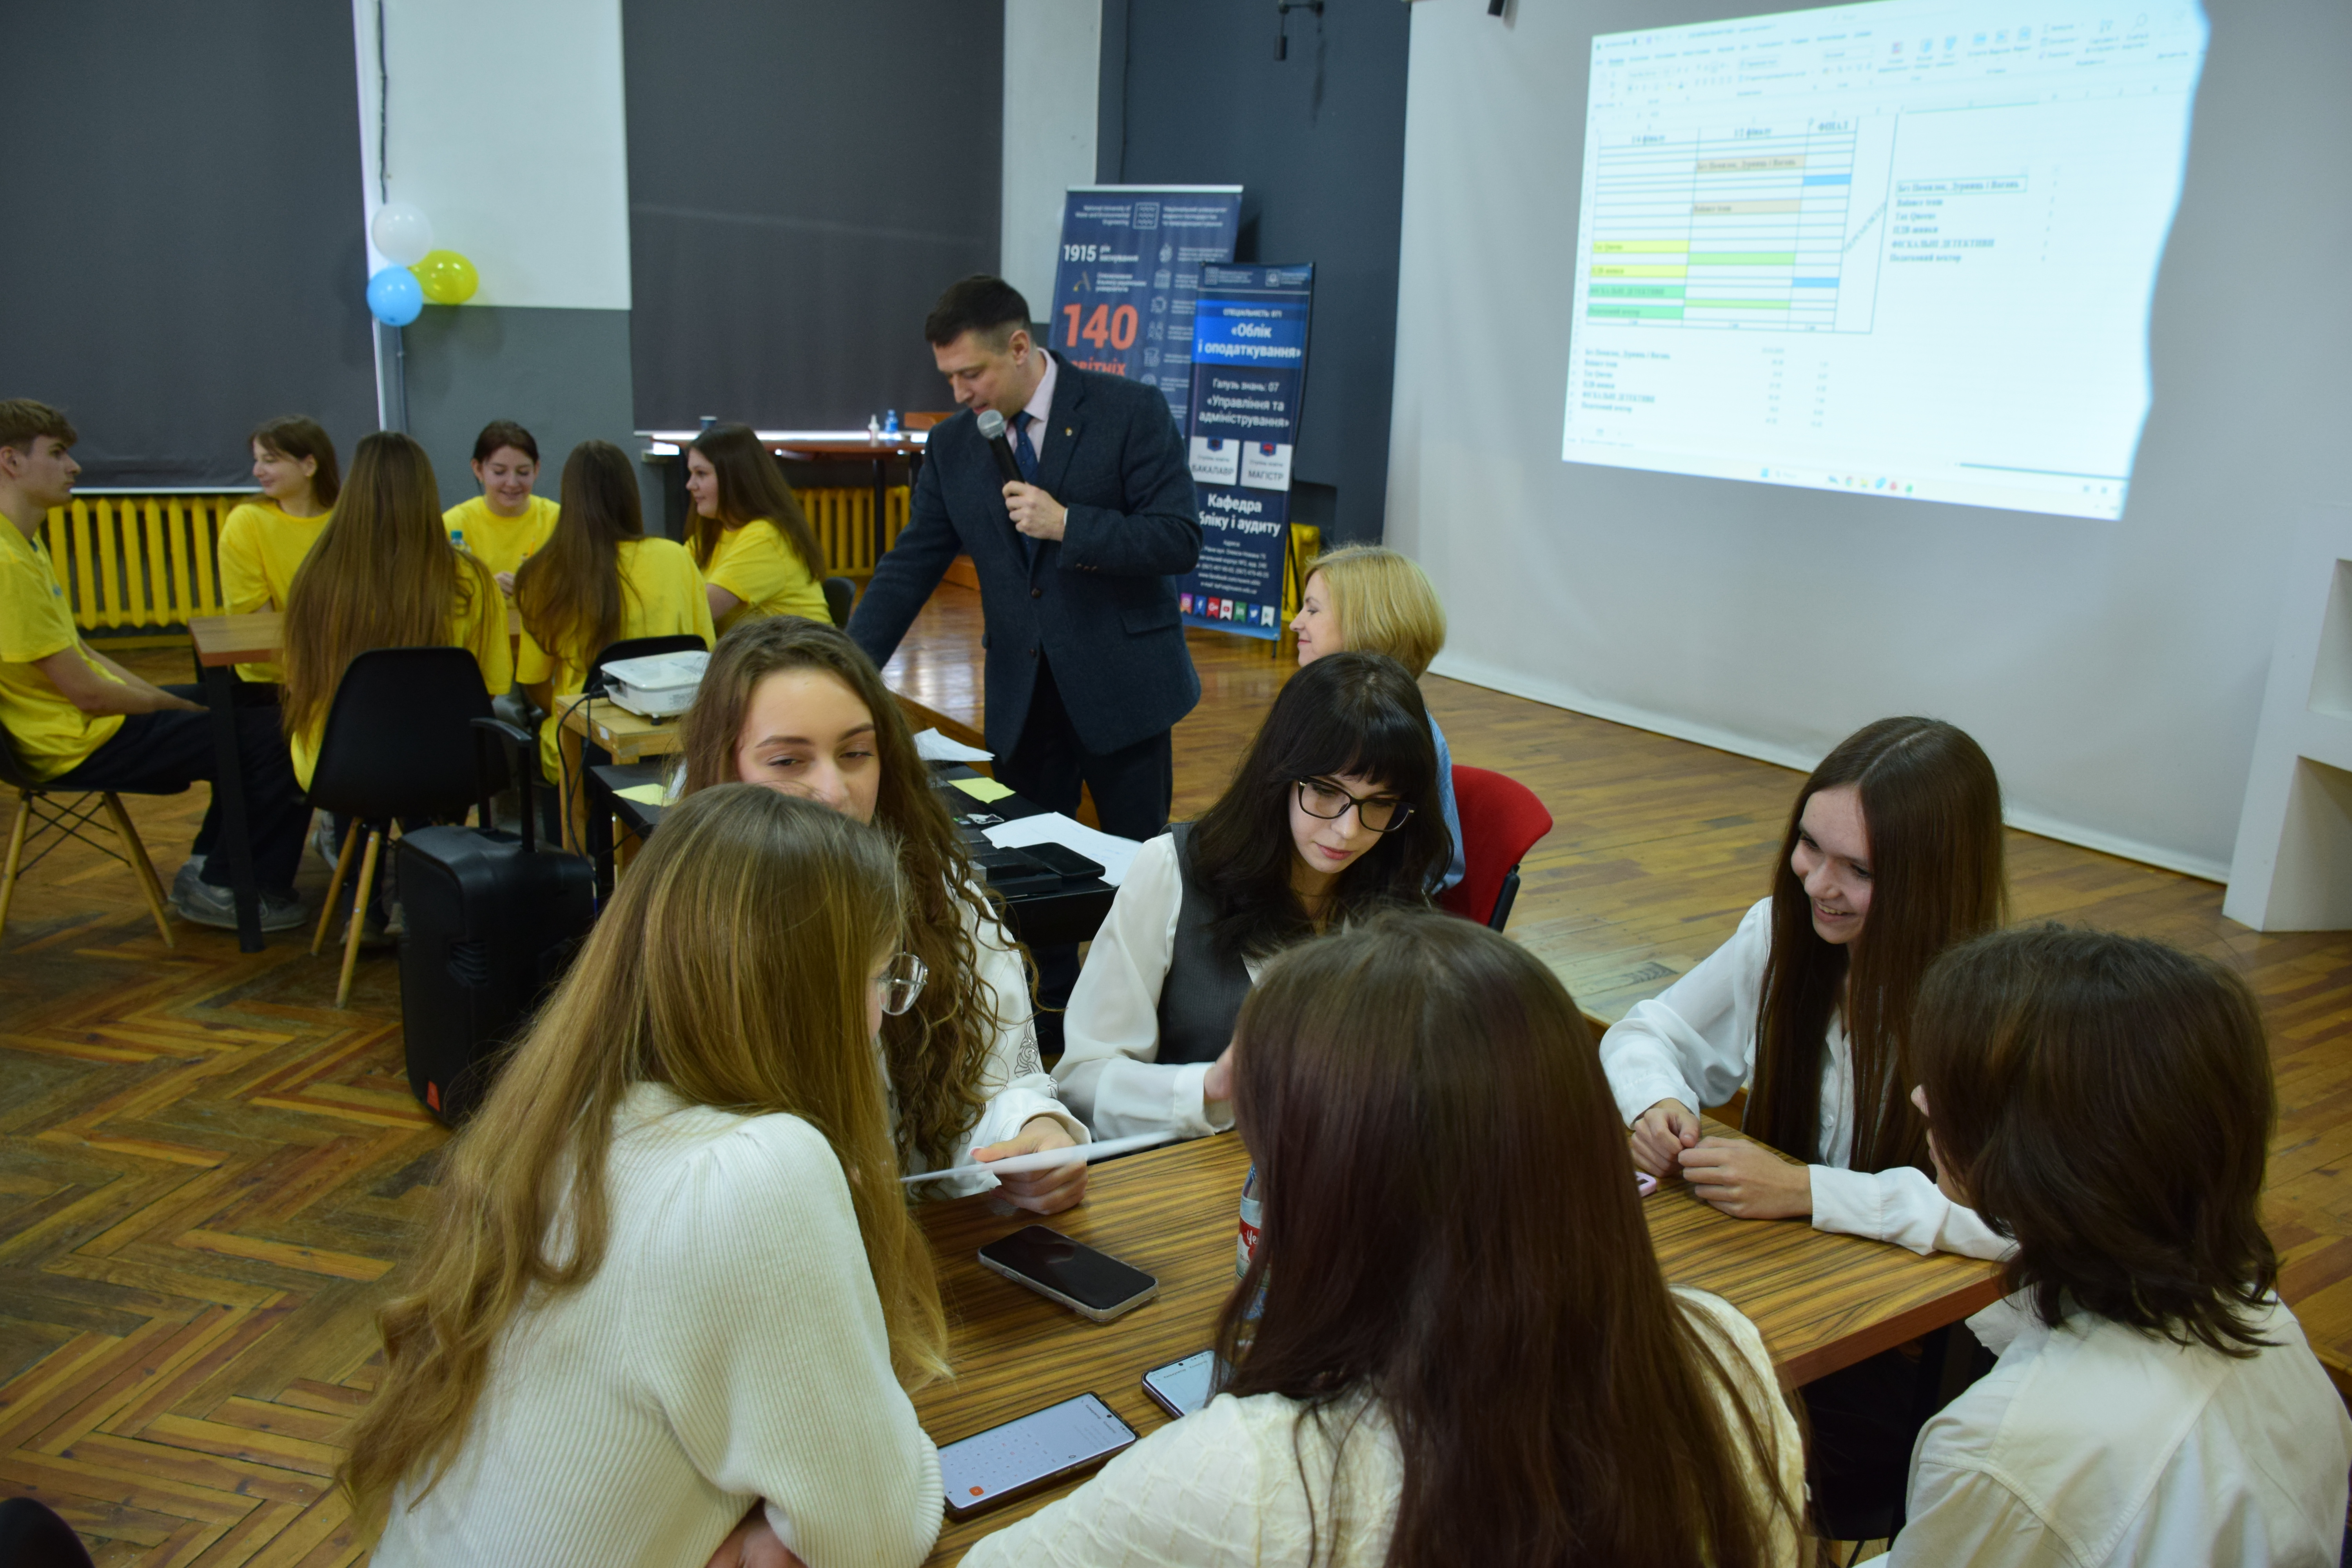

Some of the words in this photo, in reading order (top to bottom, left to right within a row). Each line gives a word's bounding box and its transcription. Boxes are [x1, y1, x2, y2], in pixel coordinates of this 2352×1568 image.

[1063, 244, 1096, 262] 1915
[1063, 303, 1138, 350] 140
[1231, 323, 1272, 338] «Облік
[1205, 342, 1301, 359] оподаткування»
[1071, 356, 1126, 376] вітніх
[1272, 401, 1284, 412] та
[1248, 470, 1284, 481] МАГІСТР
[1208, 493, 1262, 514] Кафедра
[1199, 512, 1229, 531] бліку
[1237, 519, 1281, 537] аудиту
